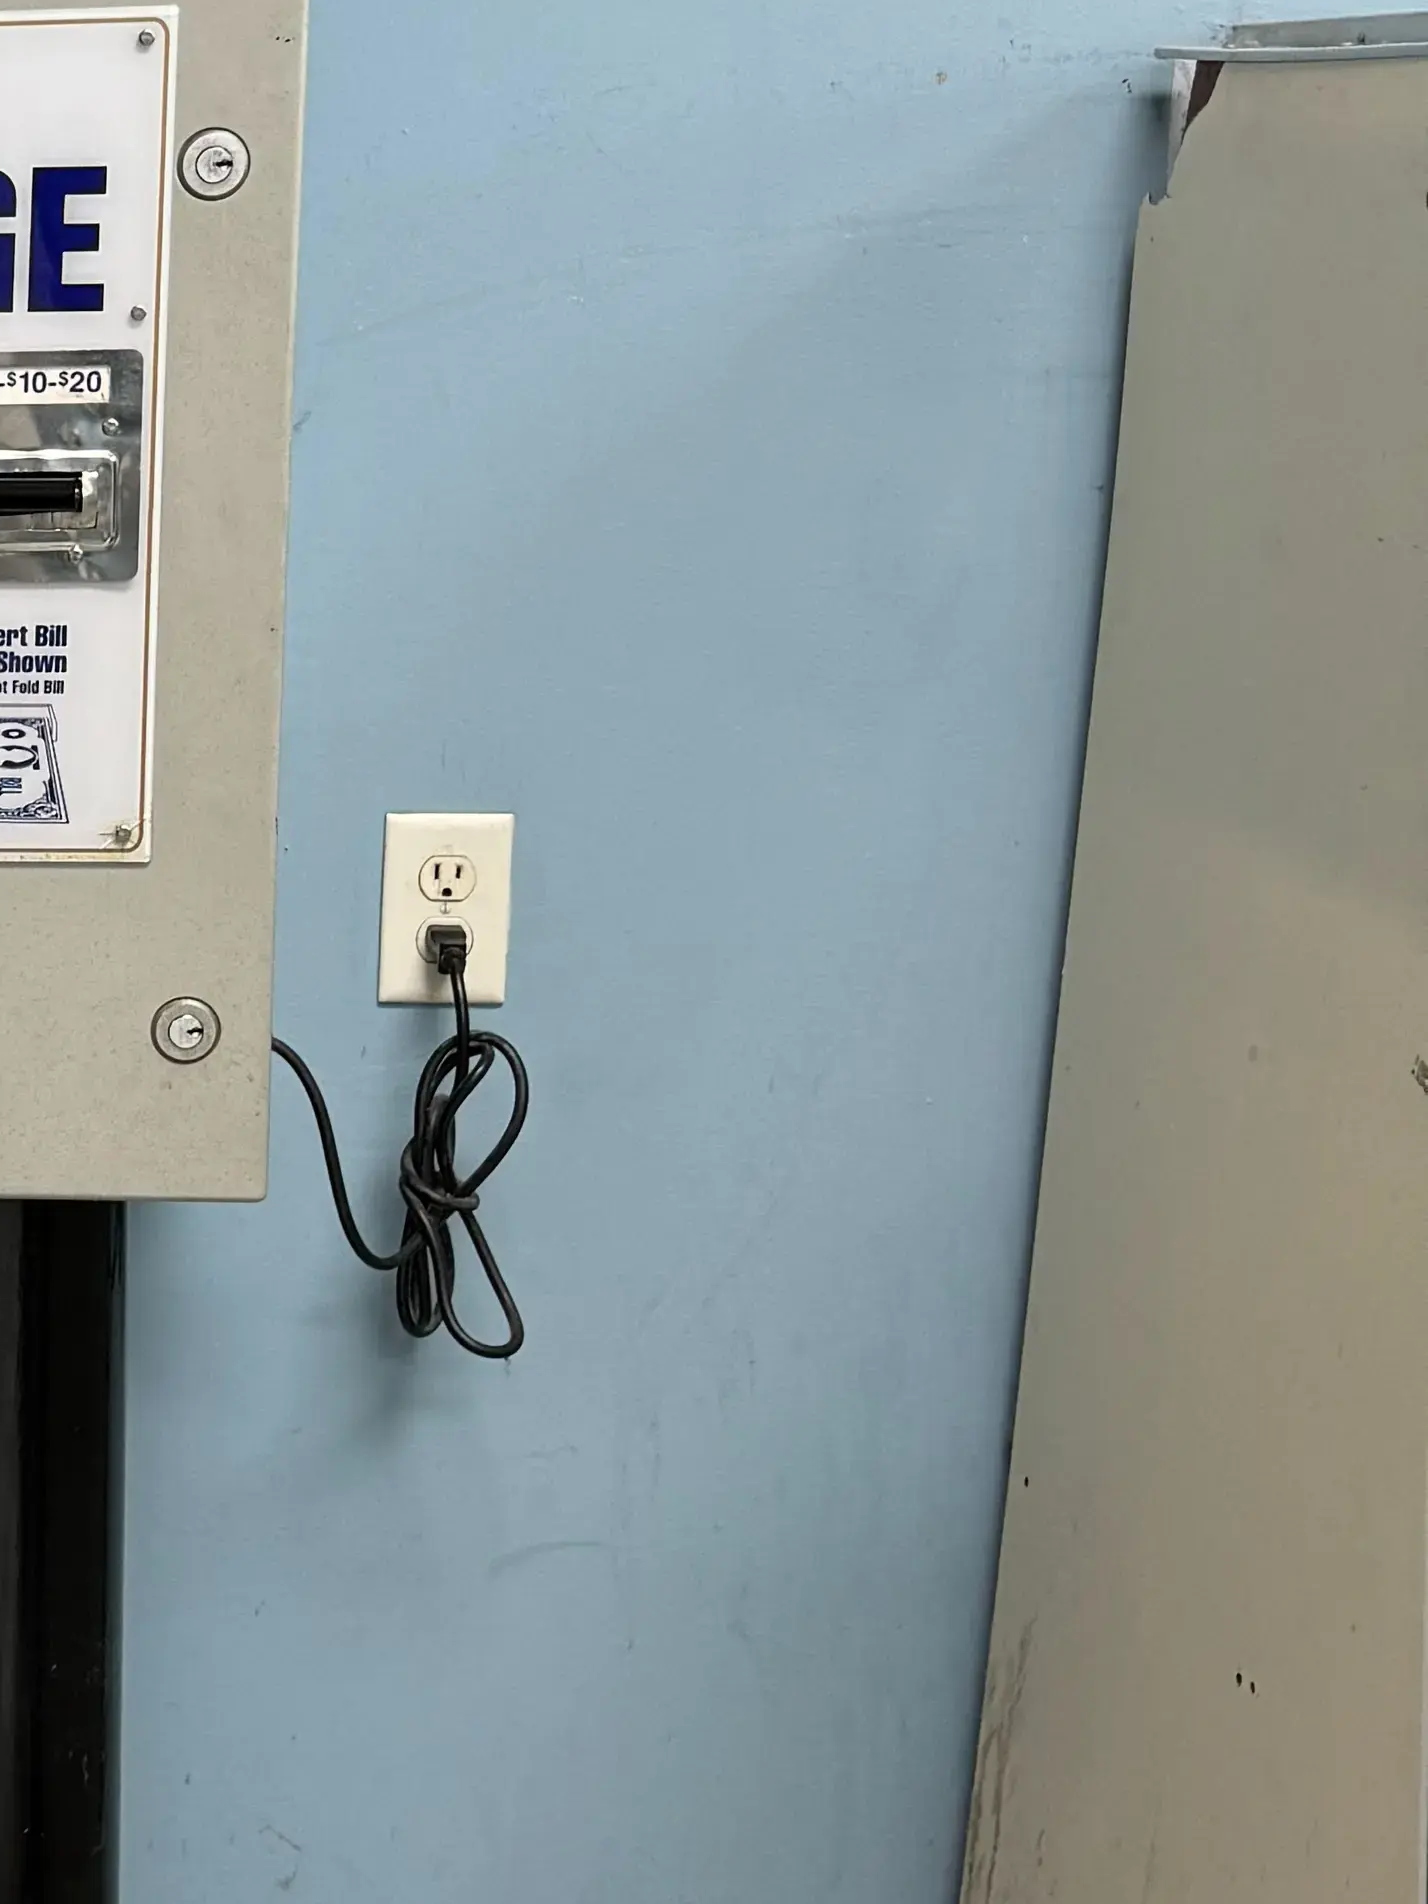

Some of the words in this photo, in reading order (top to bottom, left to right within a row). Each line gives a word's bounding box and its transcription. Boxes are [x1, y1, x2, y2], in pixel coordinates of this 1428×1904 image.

[34, 624, 68, 647] Bill
[12, 680, 39, 694] Fold
[43, 680, 65, 694] Bill
